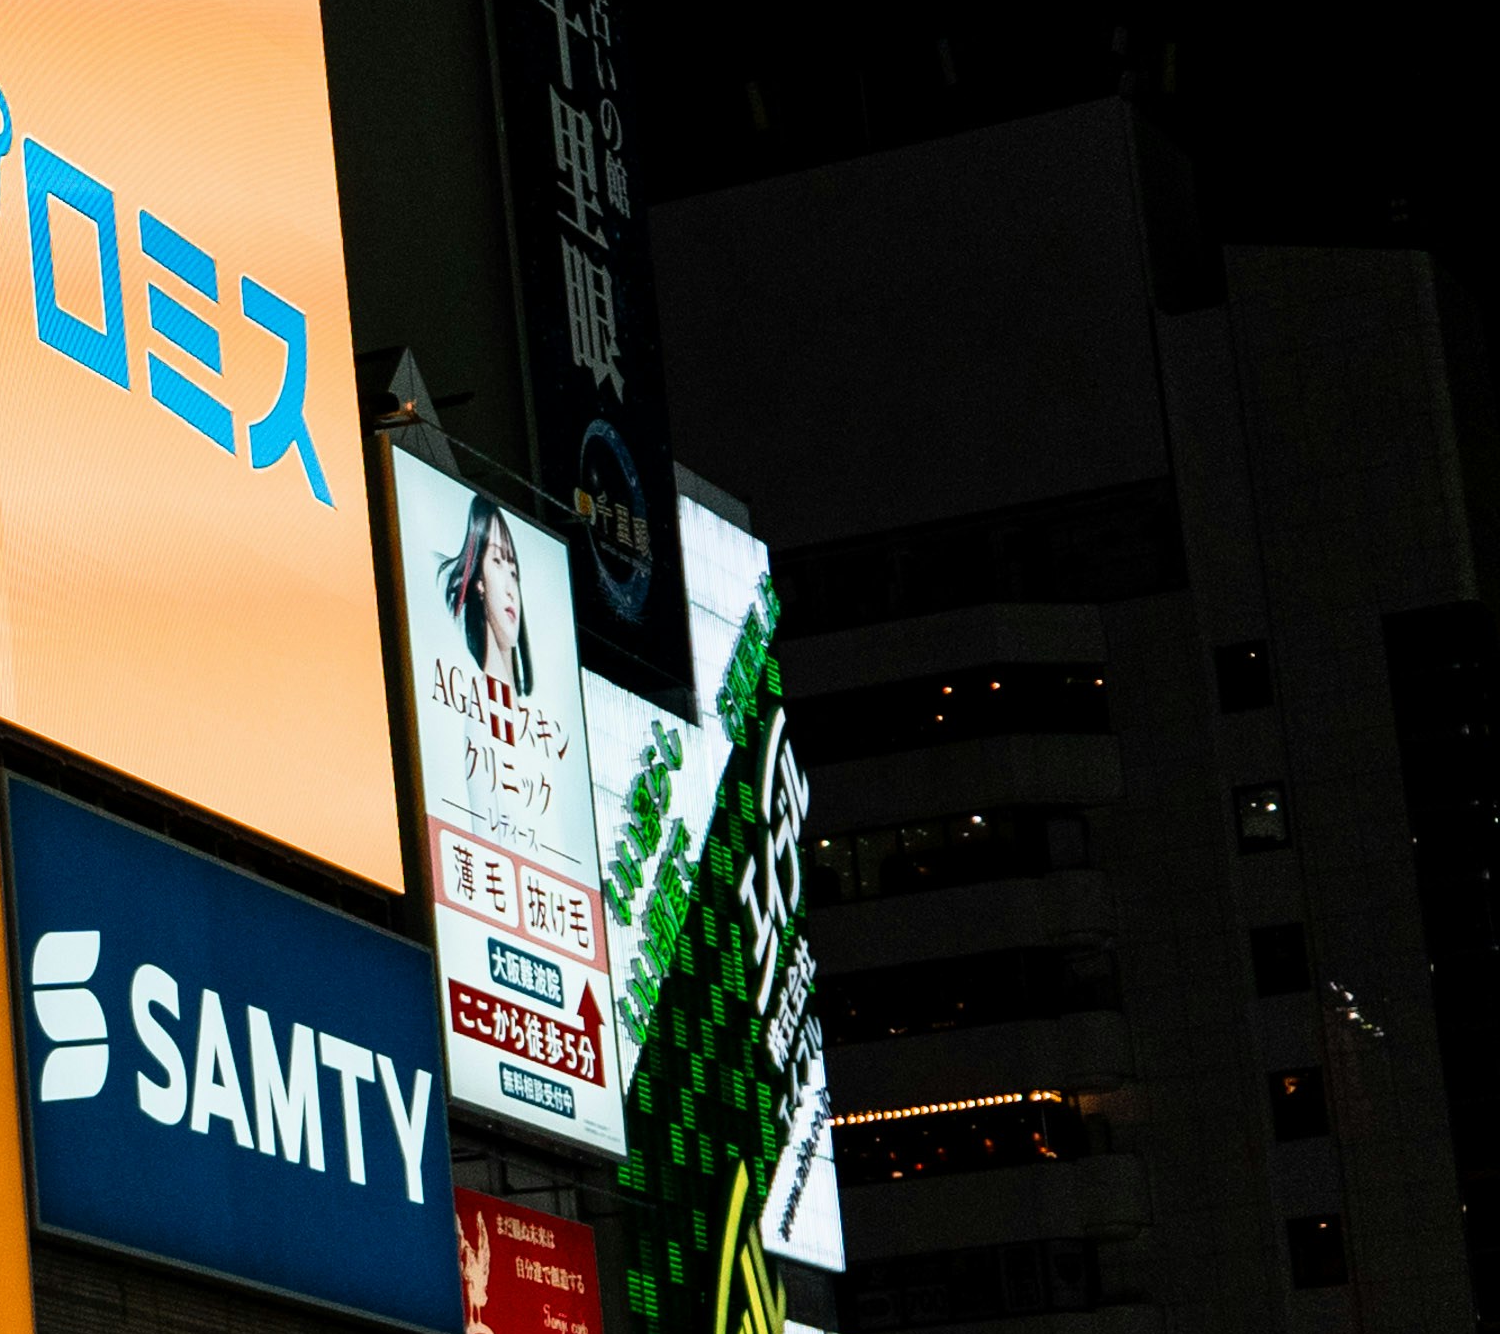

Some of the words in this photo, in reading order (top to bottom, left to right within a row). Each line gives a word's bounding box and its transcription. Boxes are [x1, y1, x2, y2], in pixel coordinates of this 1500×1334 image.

[432, 658, 487, 725] AGA
[517, 704, 570, 760] スキン
[464, 735, 551, 815] クリニック
[487, 807, 539, 852] レディース
[452, 844, 507, 914] 薄毛
[526, 876, 590, 949] 抜け毛
[491, 945, 562, 1003] 大阪難波院
[458, 991, 596, 1080] ここから徒歩5分
[129, 963, 432, 1205] SAMTY
[502, 1068, 574, 1115] 無料相談受付中
